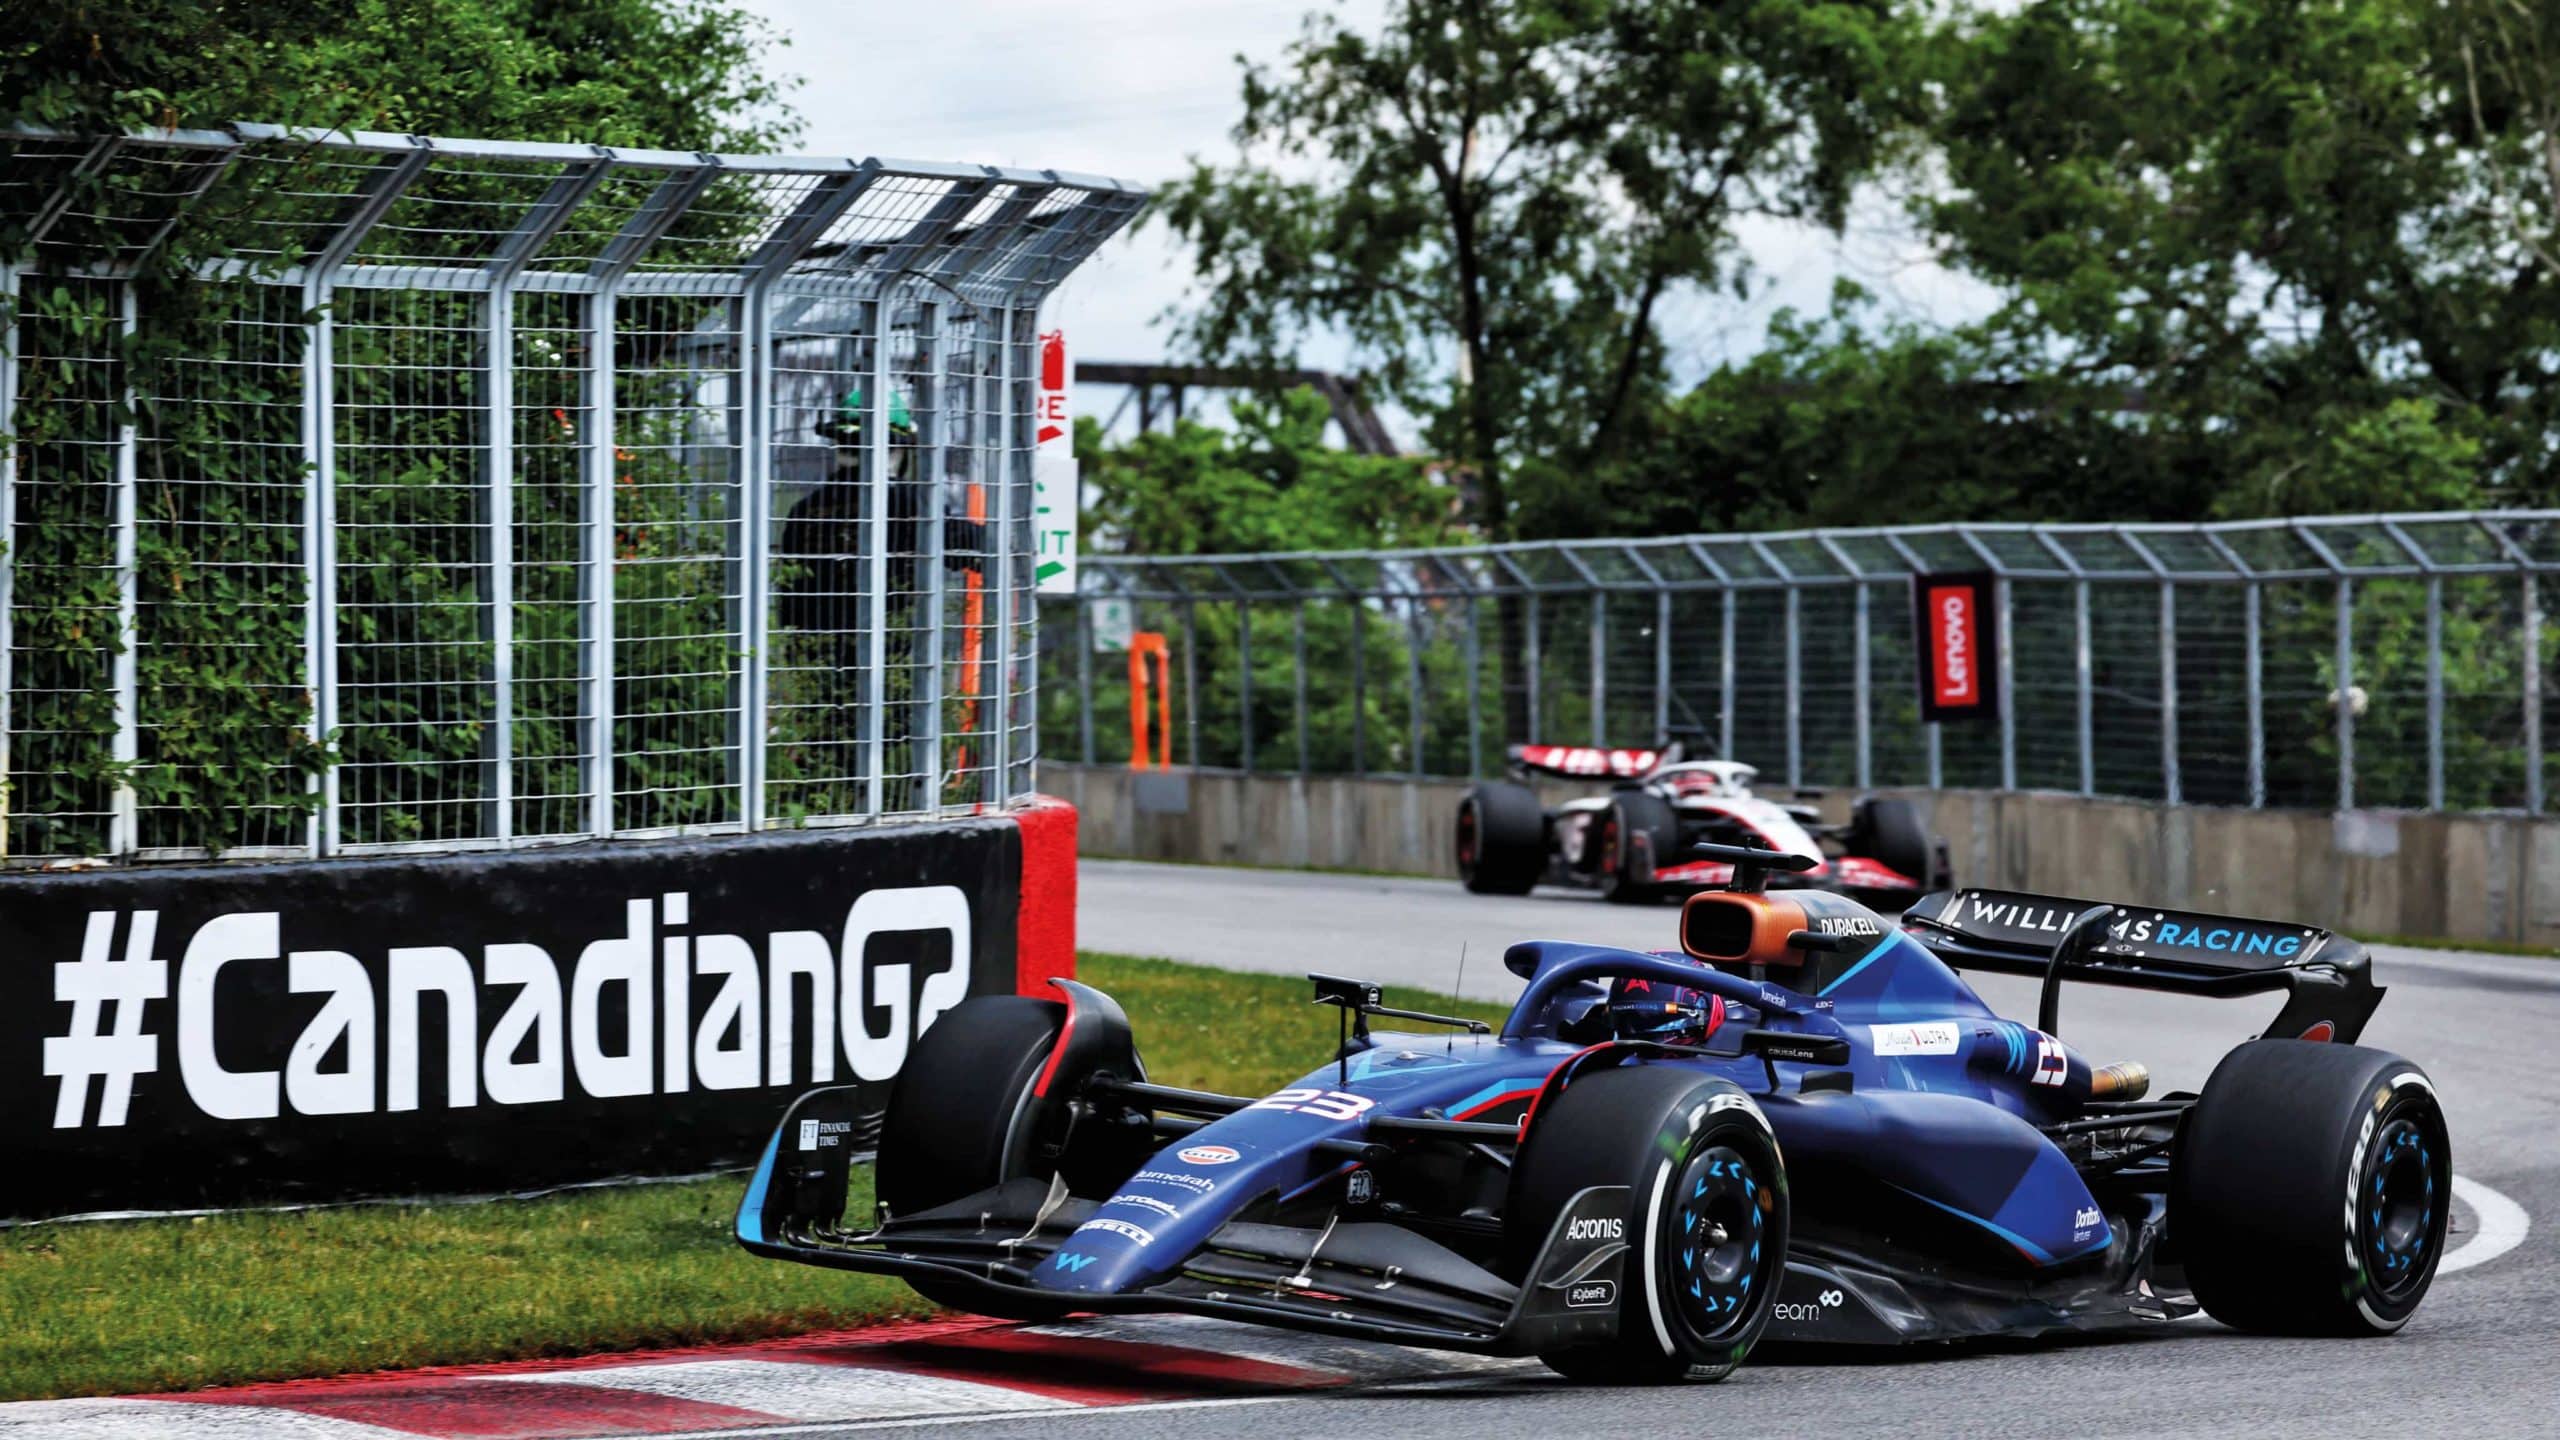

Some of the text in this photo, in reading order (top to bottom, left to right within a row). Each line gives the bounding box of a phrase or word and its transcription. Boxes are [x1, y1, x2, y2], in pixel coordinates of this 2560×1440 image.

[1944, 596, 1969, 697] Lenovo
[1820, 917, 1880, 937] DURACELL
[1974, 900, 2300, 957] WILLIMS RACING
[1767, 1047, 1815, 1058] causaLens
[1248, 1088, 1375, 1121] 23
[802, 1123, 817, 1139] FT
[819, 1135, 839, 1146] TIMES
[1349, 1177, 1371, 1197] FIA
[1566, 1215, 1623, 1240] Acronis
[1572, 1287, 1606, 1302] #CyberFit
[1773, 1303, 1820, 1321] eam
